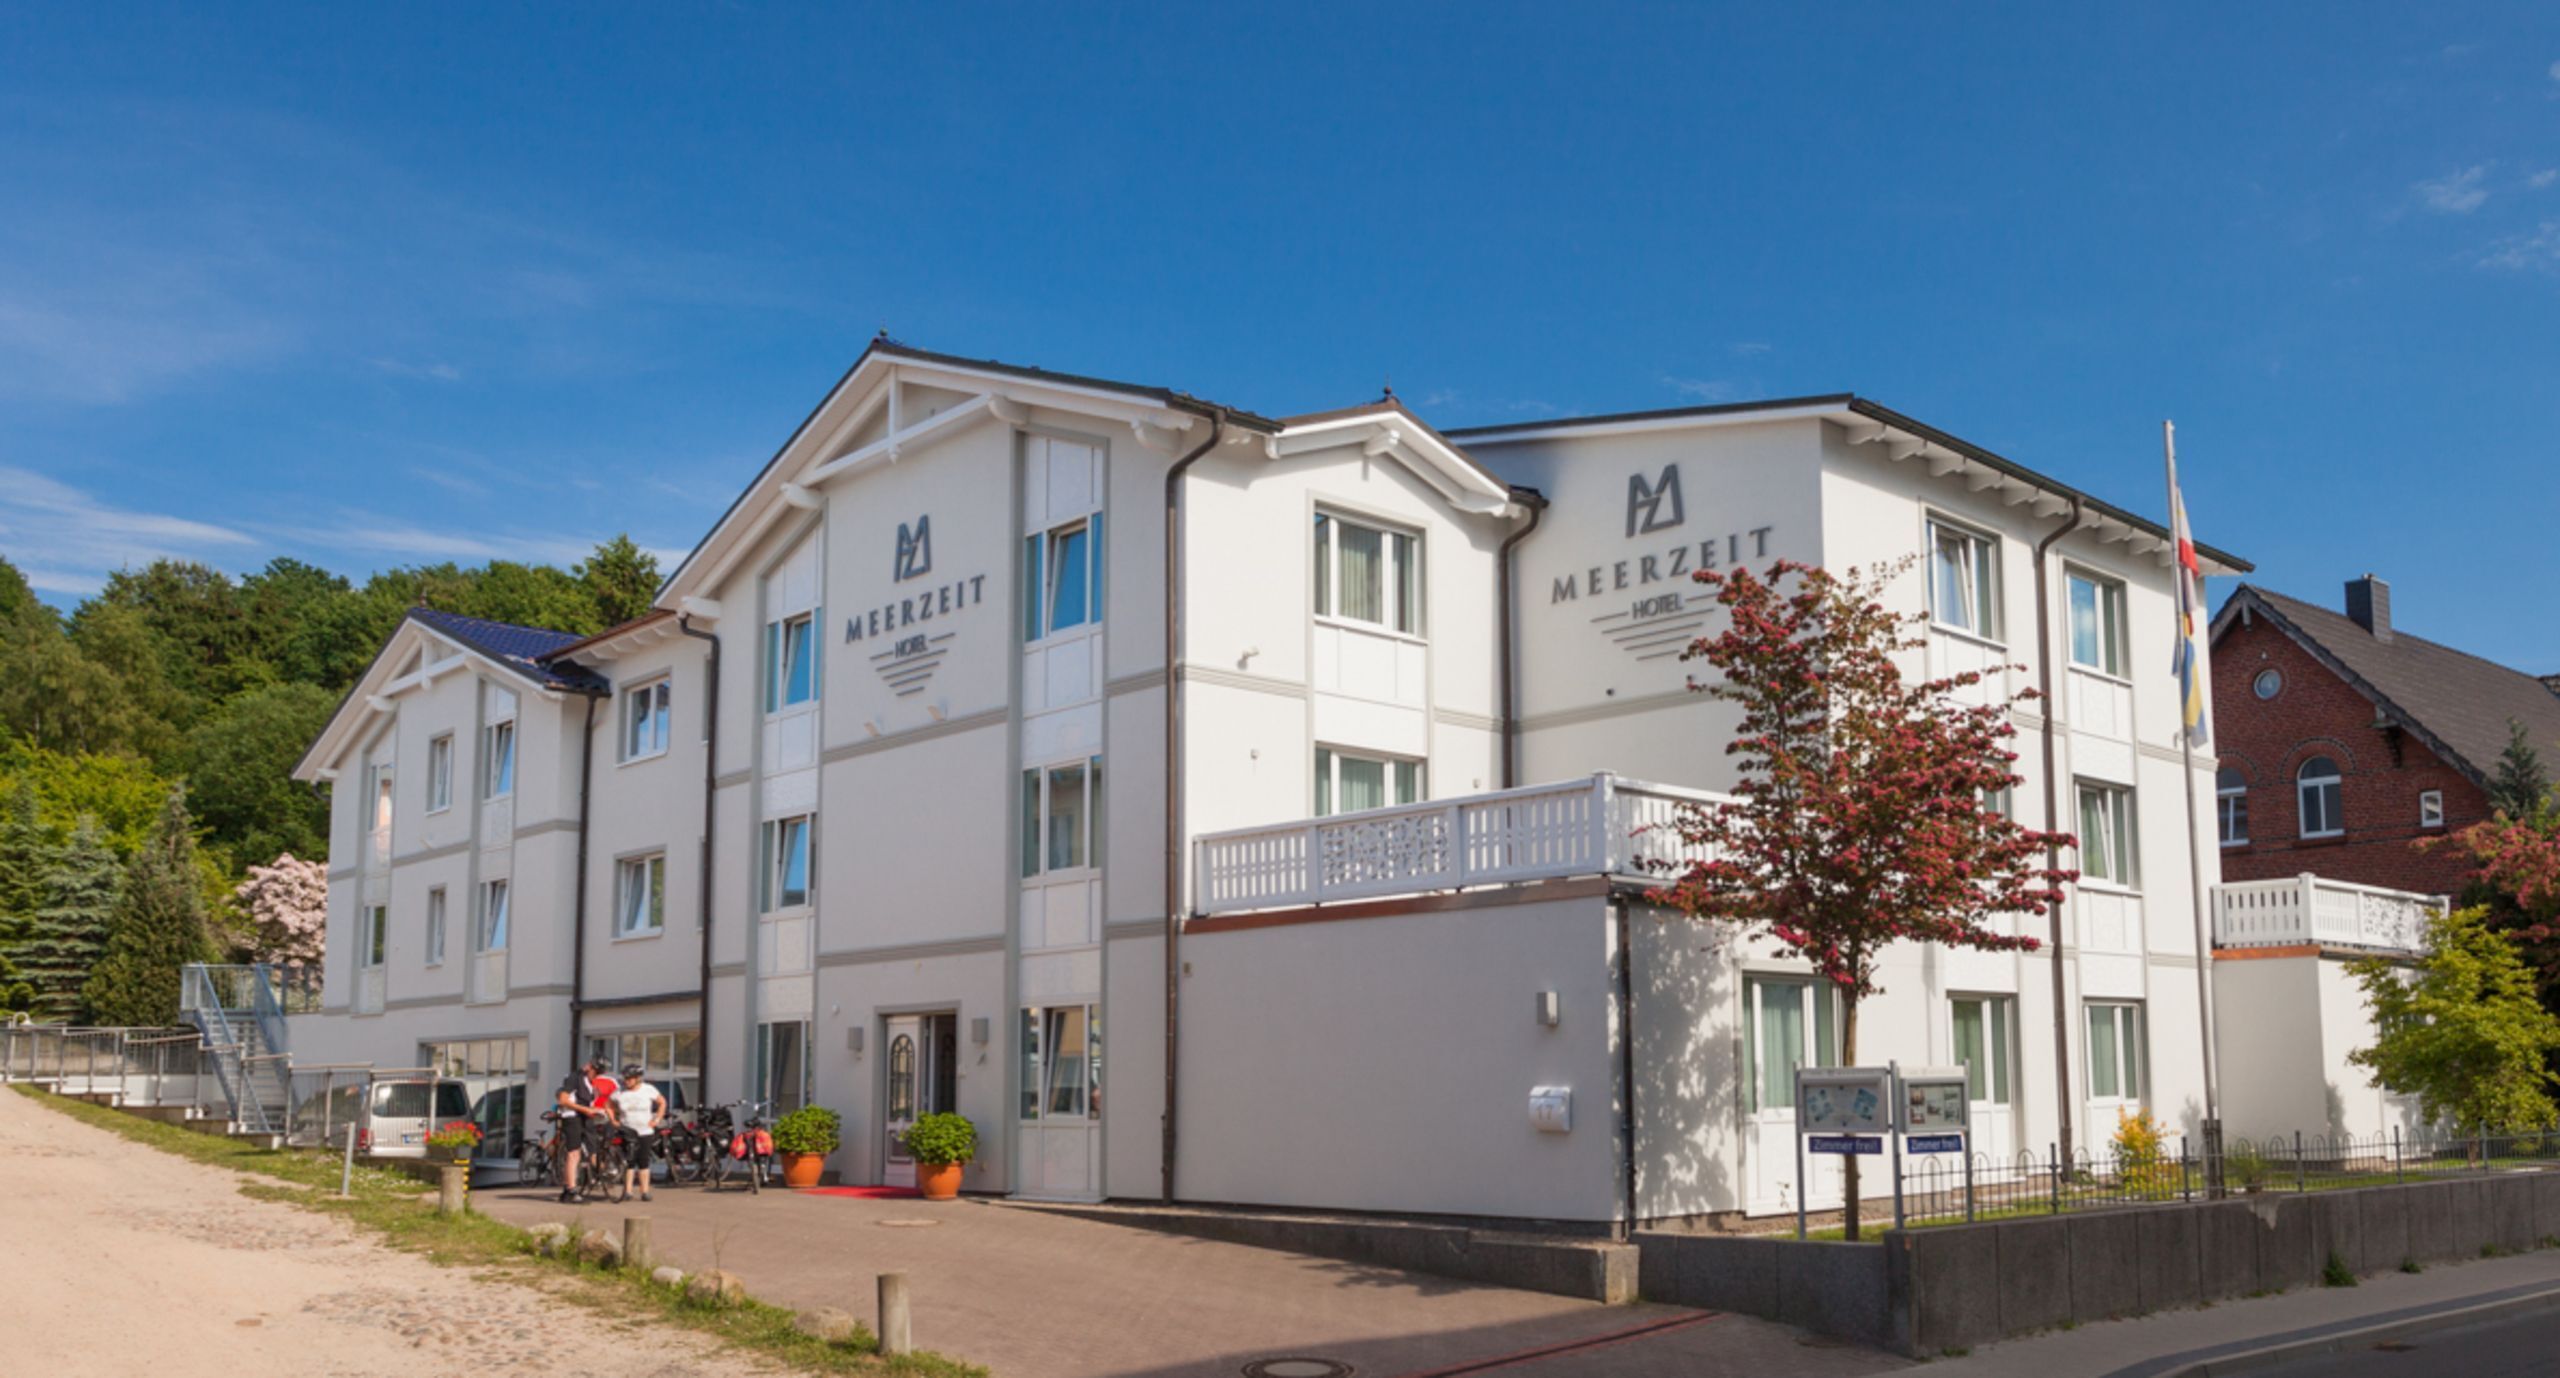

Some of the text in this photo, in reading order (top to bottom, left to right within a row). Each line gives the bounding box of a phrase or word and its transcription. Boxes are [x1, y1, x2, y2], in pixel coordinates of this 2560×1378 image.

[1551, 526, 1773, 604] MEERZEIT
[845, 574, 985, 644] MEERZEIT
[1632, 592, 1684, 620] HOTEL
[895, 633, 928, 659] HOTEL
